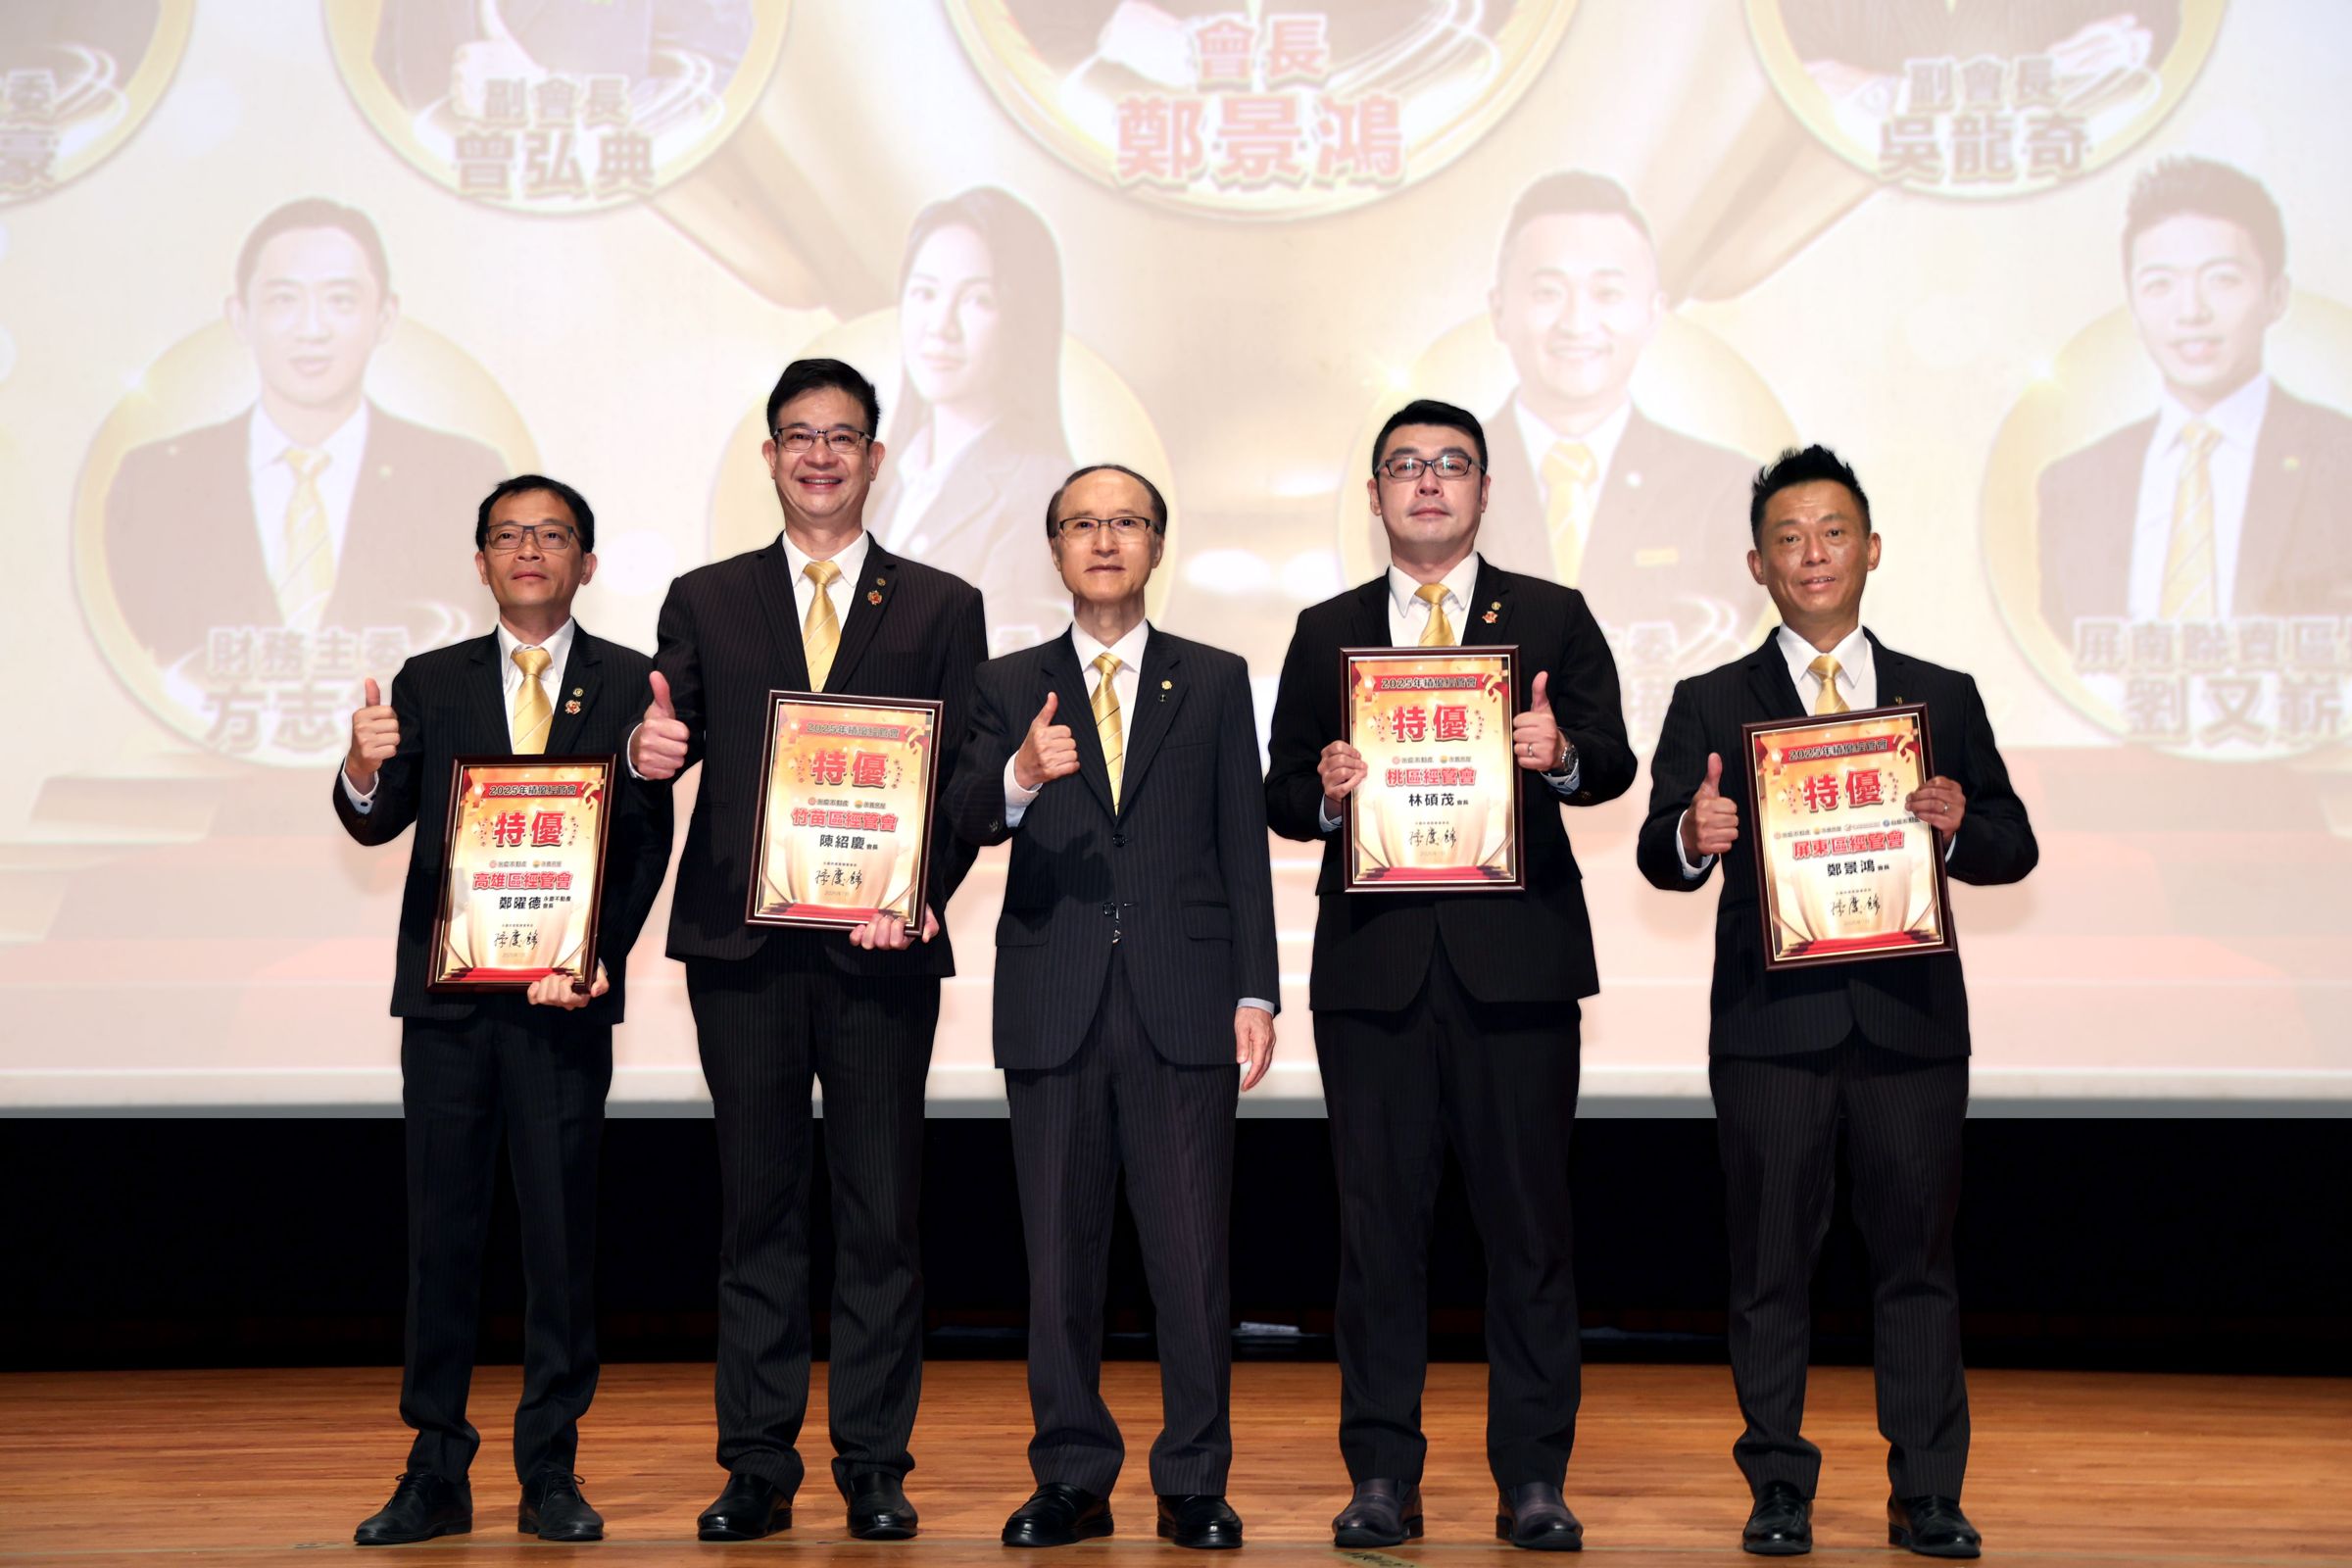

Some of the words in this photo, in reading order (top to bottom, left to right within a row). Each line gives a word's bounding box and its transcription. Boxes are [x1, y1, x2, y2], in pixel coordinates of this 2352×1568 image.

[1197, 18, 1329, 84] 會長
[0, 72, 53, 115] 委
[484, 76, 628, 121] 副會長
[1909, 60, 2056, 103] 副會長
[454, 128, 655, 191] 曾弘典
[1116, 95, 1402, 181] 鄭景鴻
[1879, 112, 2088, 178] 吳龍奇
[212, 629, 406, 674] 財務主委
[2079, 620, 2352, 667] 屏南聯賣區
[203, 683, 390, 743] 方志
[1392, 705, 1469, 742] 特優
[811, 748, 888, 789] 特優
[1408, 792, 1455, 807] 林碩茂
[1804, 768, 1885, 813] 特優
[494, 809, 566, 847] 特優
[819, 834, 865, 850] 陳紹慶
[472, 871, 573, 890] 高雄區經管會
[1827, 858, 1876, 877] 鄭景鴻
[499, 896, 541, 909] 鄭曜德
